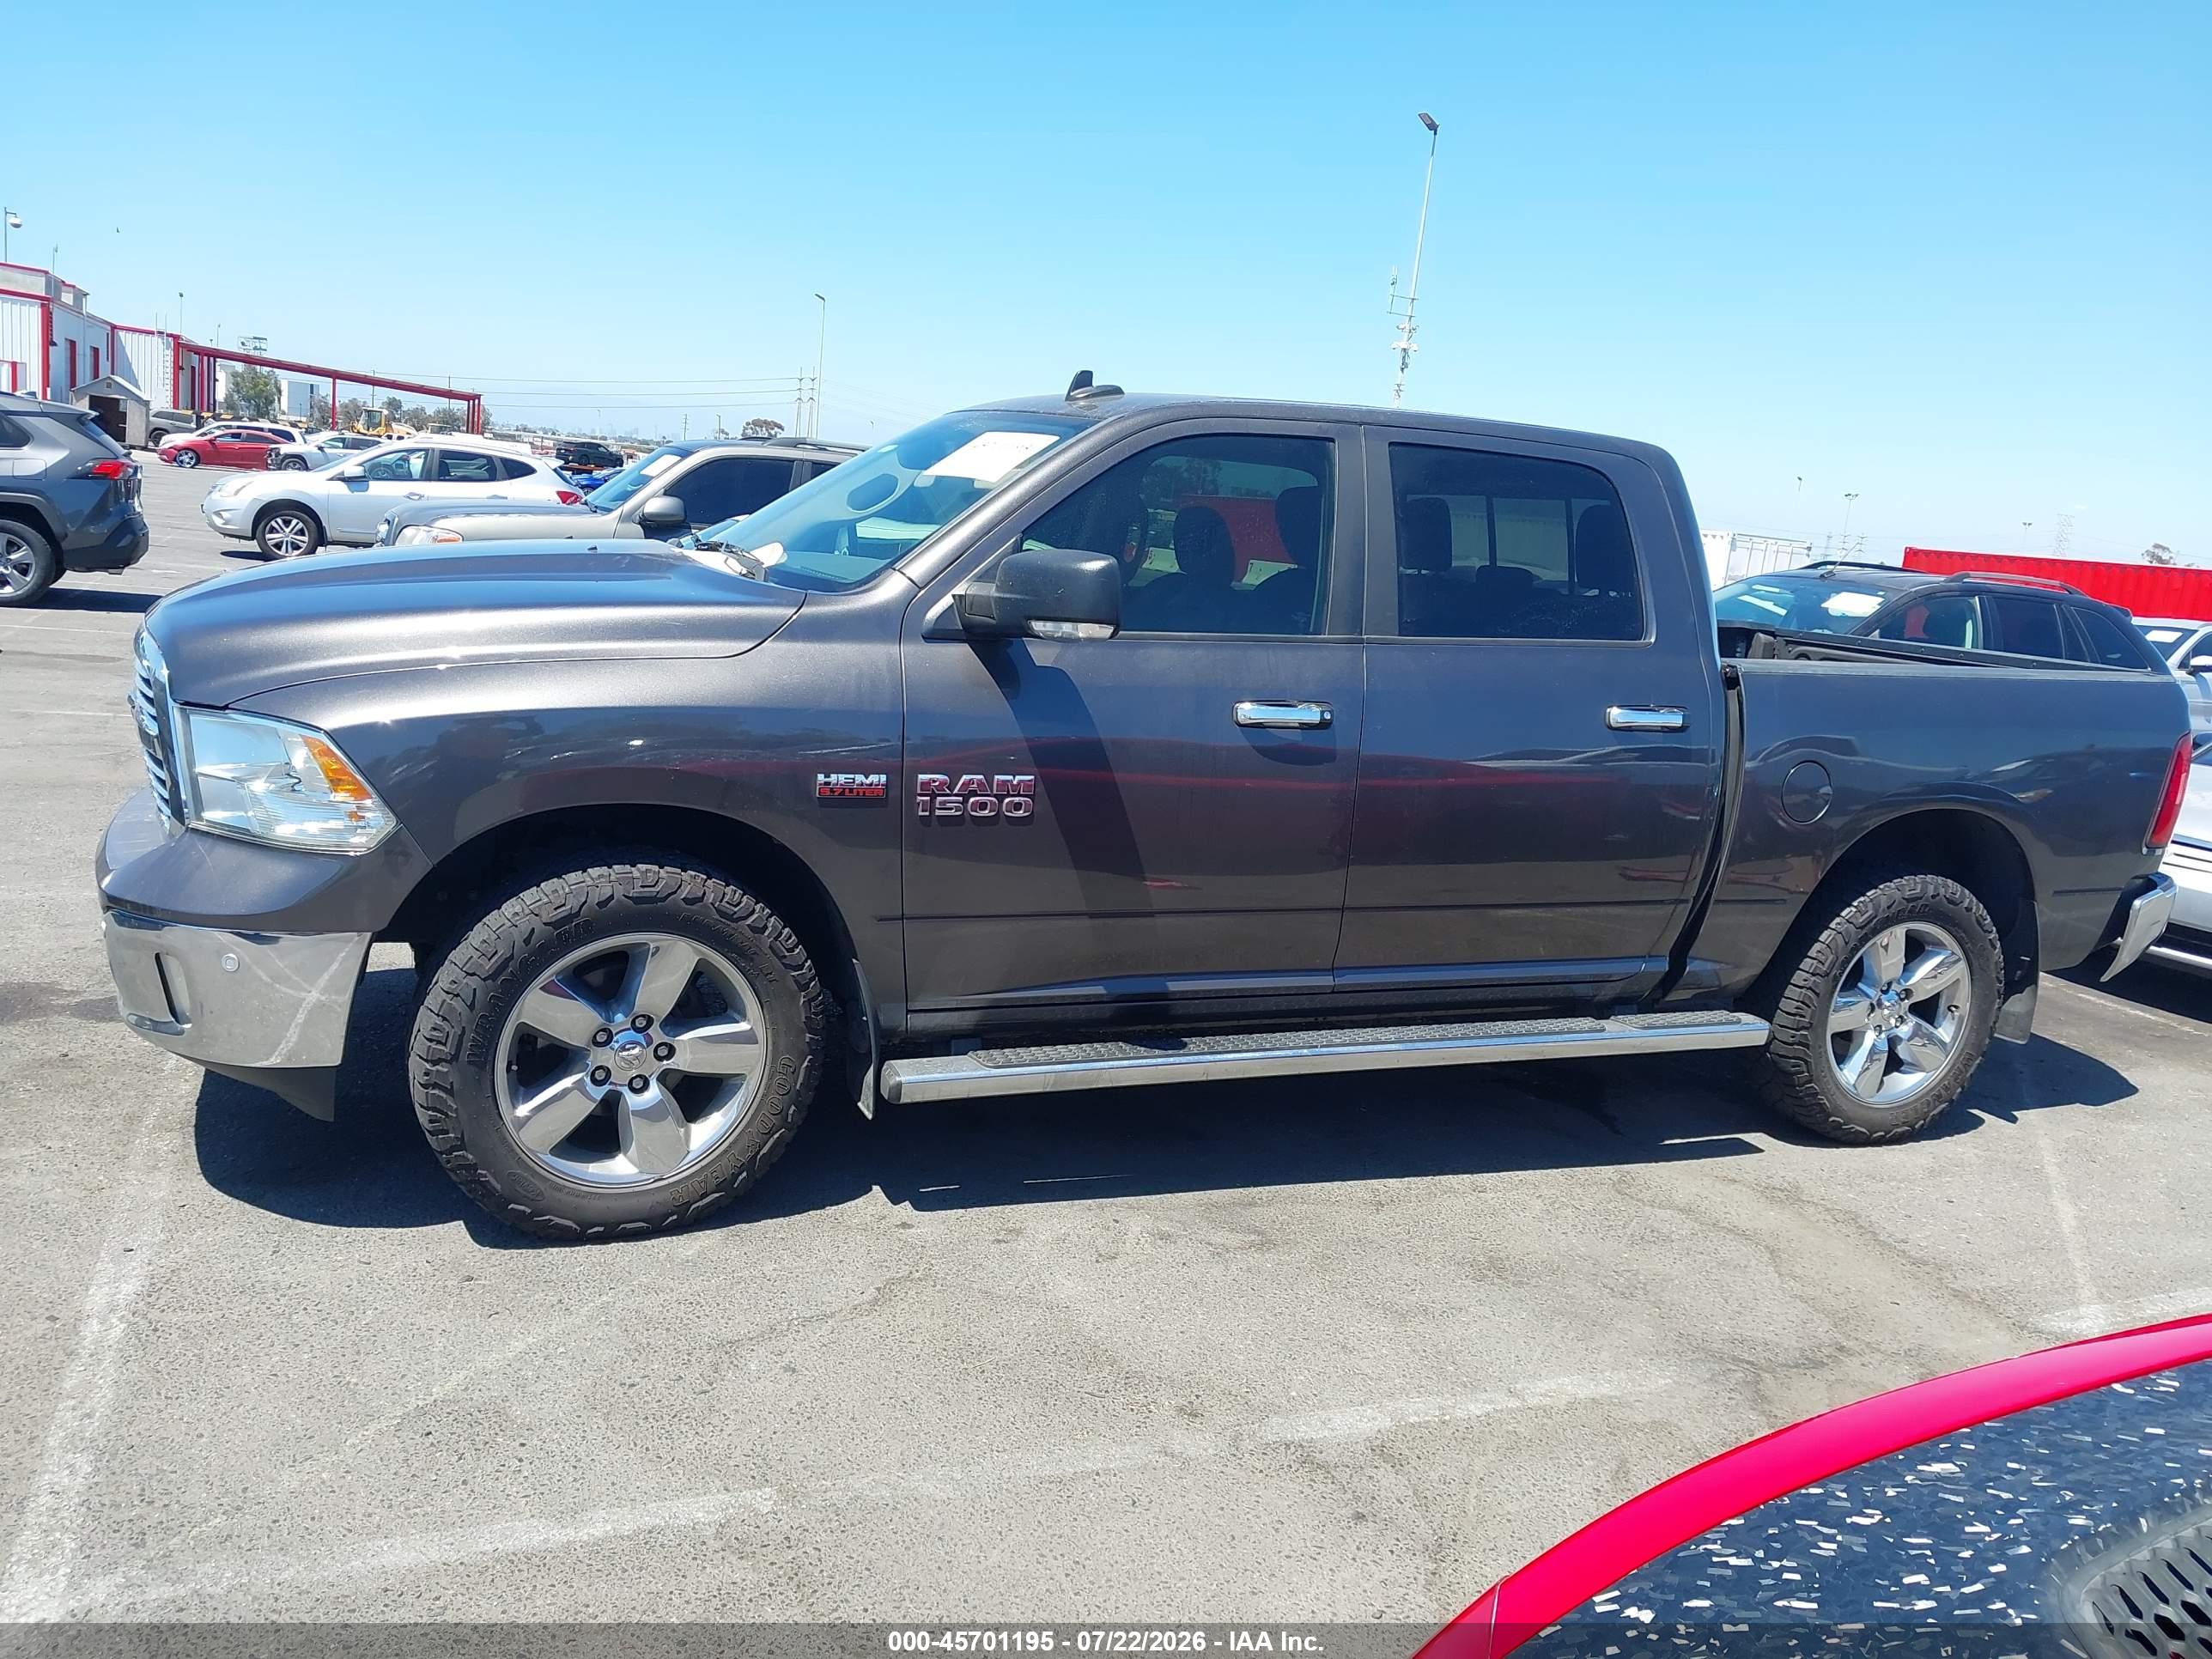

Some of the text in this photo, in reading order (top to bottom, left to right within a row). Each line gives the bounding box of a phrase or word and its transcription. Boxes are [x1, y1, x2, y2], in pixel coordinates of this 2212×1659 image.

[817, 773, 887, 788] HEMI
[916, 774, 1036, 795] RAM
[819, 787, 884, 797] 5.7 LITER
[915, 796, 1035, 817] 1500
